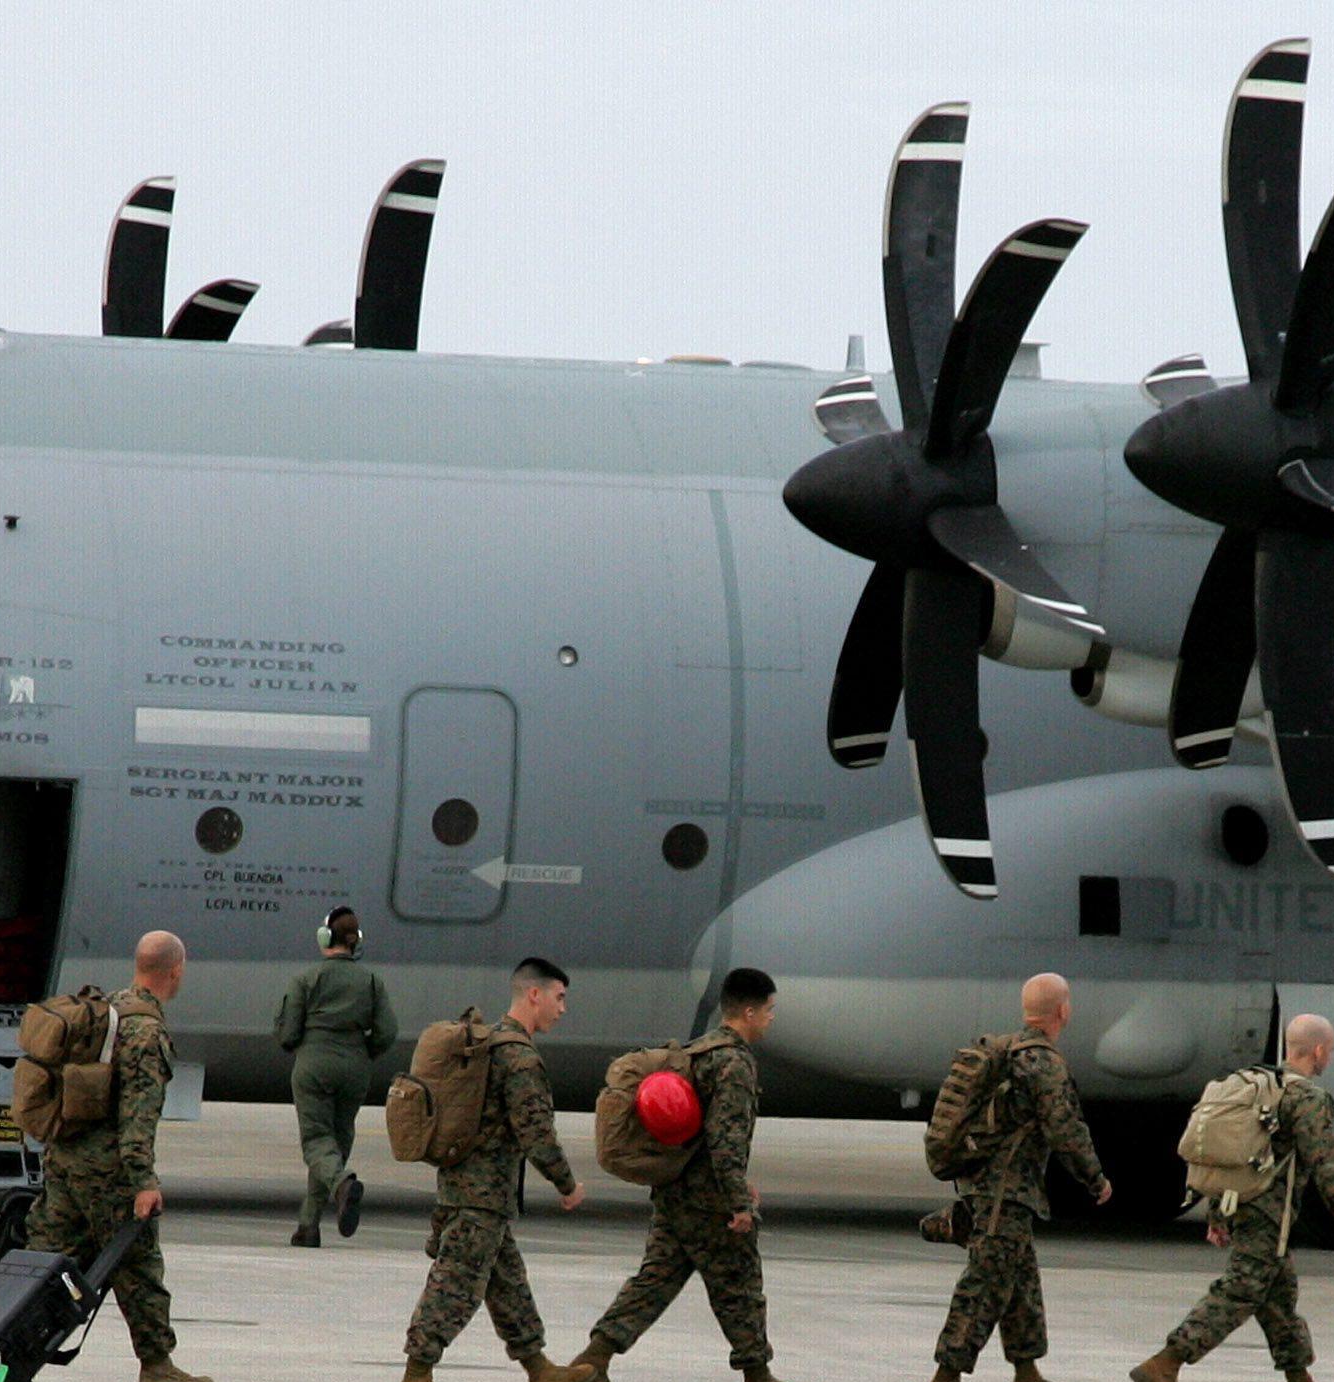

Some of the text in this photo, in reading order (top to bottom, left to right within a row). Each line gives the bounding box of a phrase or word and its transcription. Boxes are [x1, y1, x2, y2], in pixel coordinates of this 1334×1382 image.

[160, 635, 346, 654] COMMANDING
[193, 656, 315, 672] OFFICER
[145, 673, 358, 693] LTCOL JULIAN
[127, 766, 364, 788] SERGEANT MAJOR
[129, 786, 364, 808] SGT MAJ MADDUX
[203, 870, 225, 883] CPL
[511, 868, 582, 880] RESCUE
[206, 899, 280, 913] LCPL REYES
